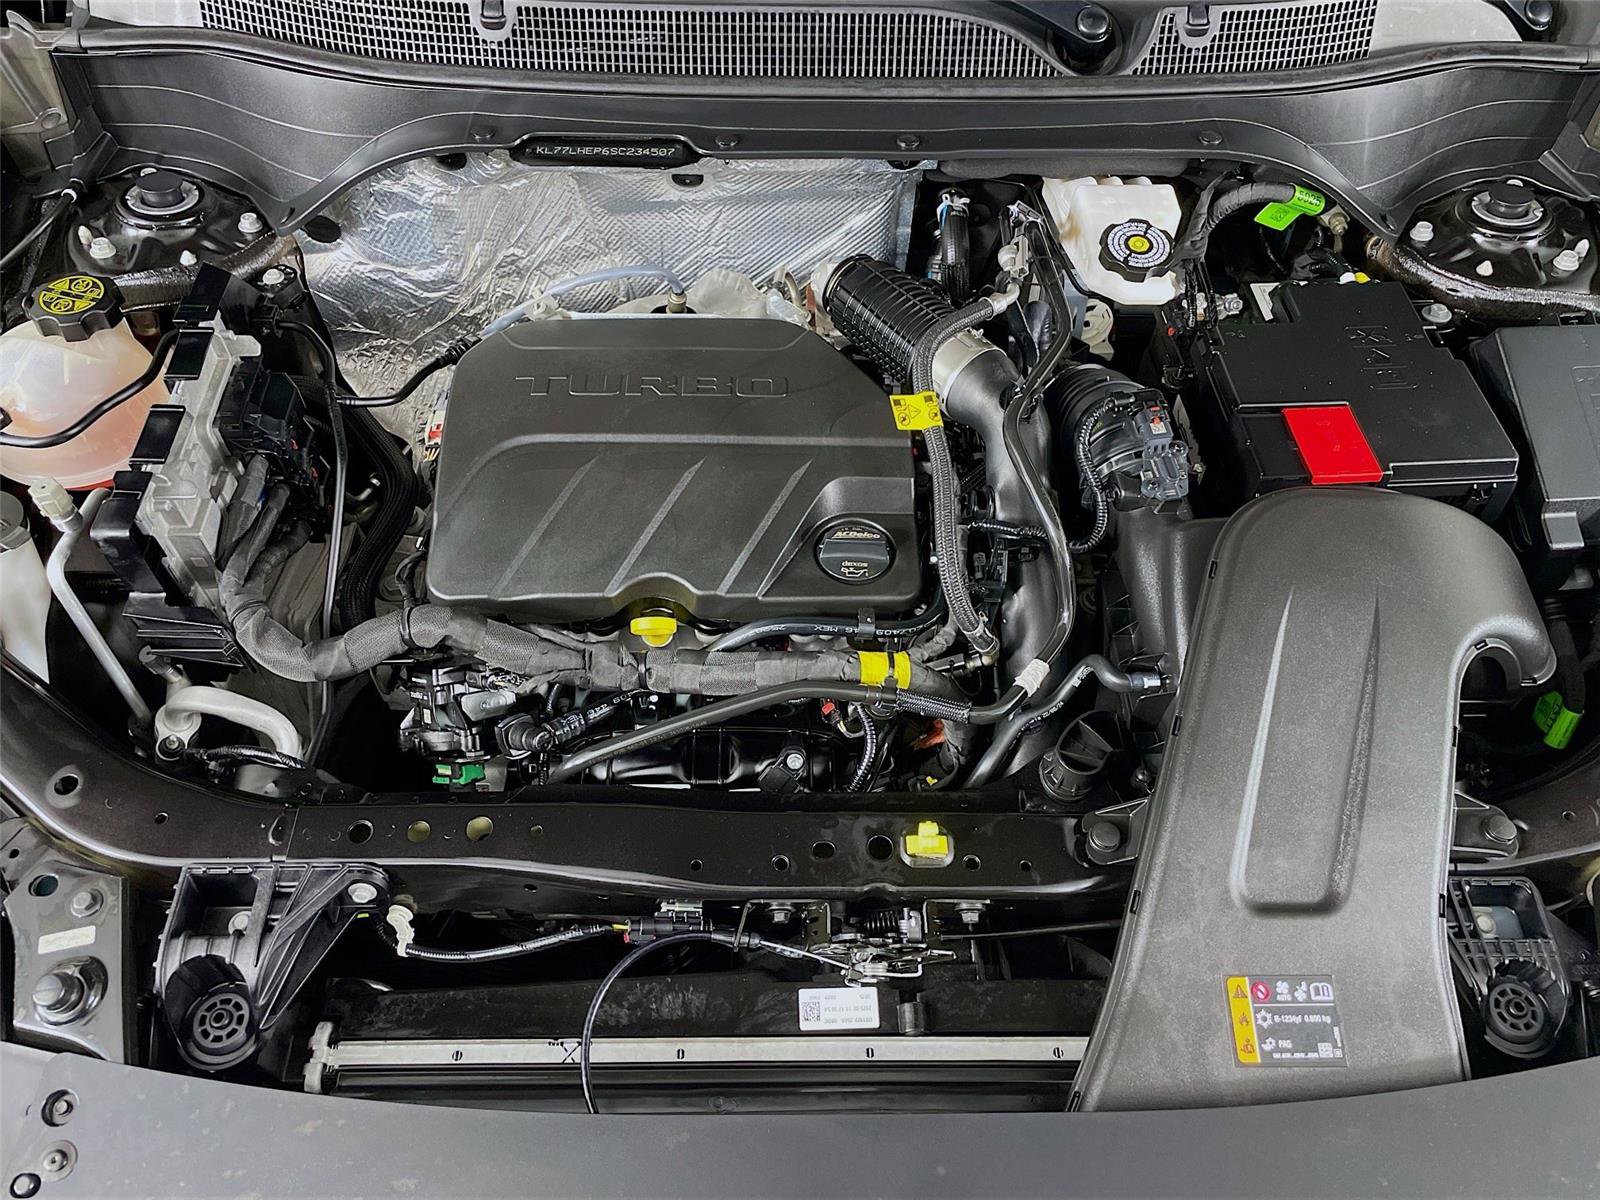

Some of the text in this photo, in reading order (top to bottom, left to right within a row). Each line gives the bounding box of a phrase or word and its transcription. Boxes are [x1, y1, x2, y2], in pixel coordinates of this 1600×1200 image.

[535, 146, 676, 156] KL77LHEP6SC234507
[515, 374, 789, 398] TURBO
[831, 530, 881, 539] ACDelco
[841, 560, 869, 568] dexos
[814, 624, 838, 633] MEX
